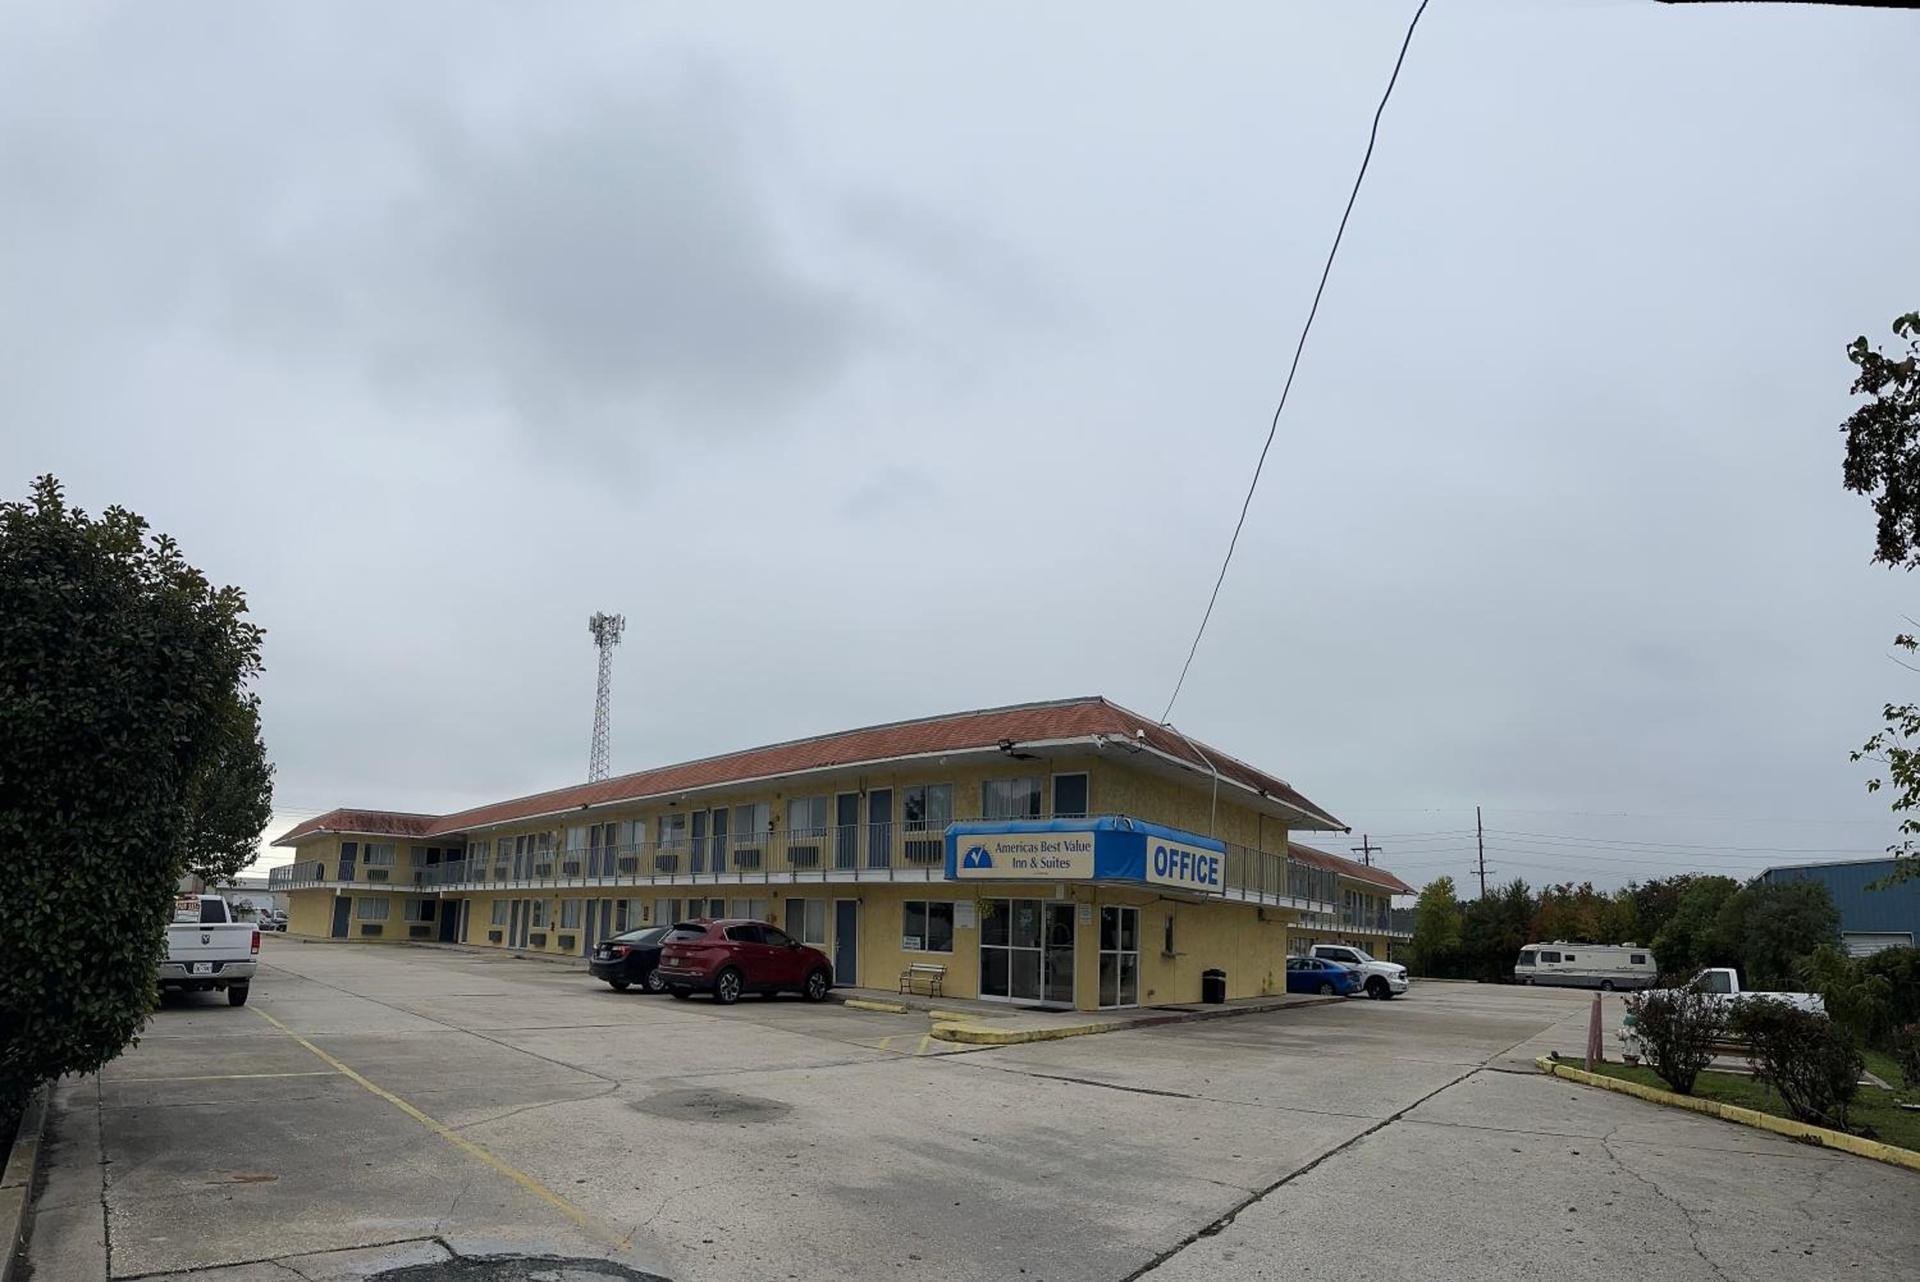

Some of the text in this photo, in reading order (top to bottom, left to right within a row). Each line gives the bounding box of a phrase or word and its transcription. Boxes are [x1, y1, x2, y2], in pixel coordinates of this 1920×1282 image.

[995, 839, 1092, 854] Americas Best Value
[1012, 856, 1071, 869] Inn & Suites
[1154, 845, 1218, 885] OFFICE
